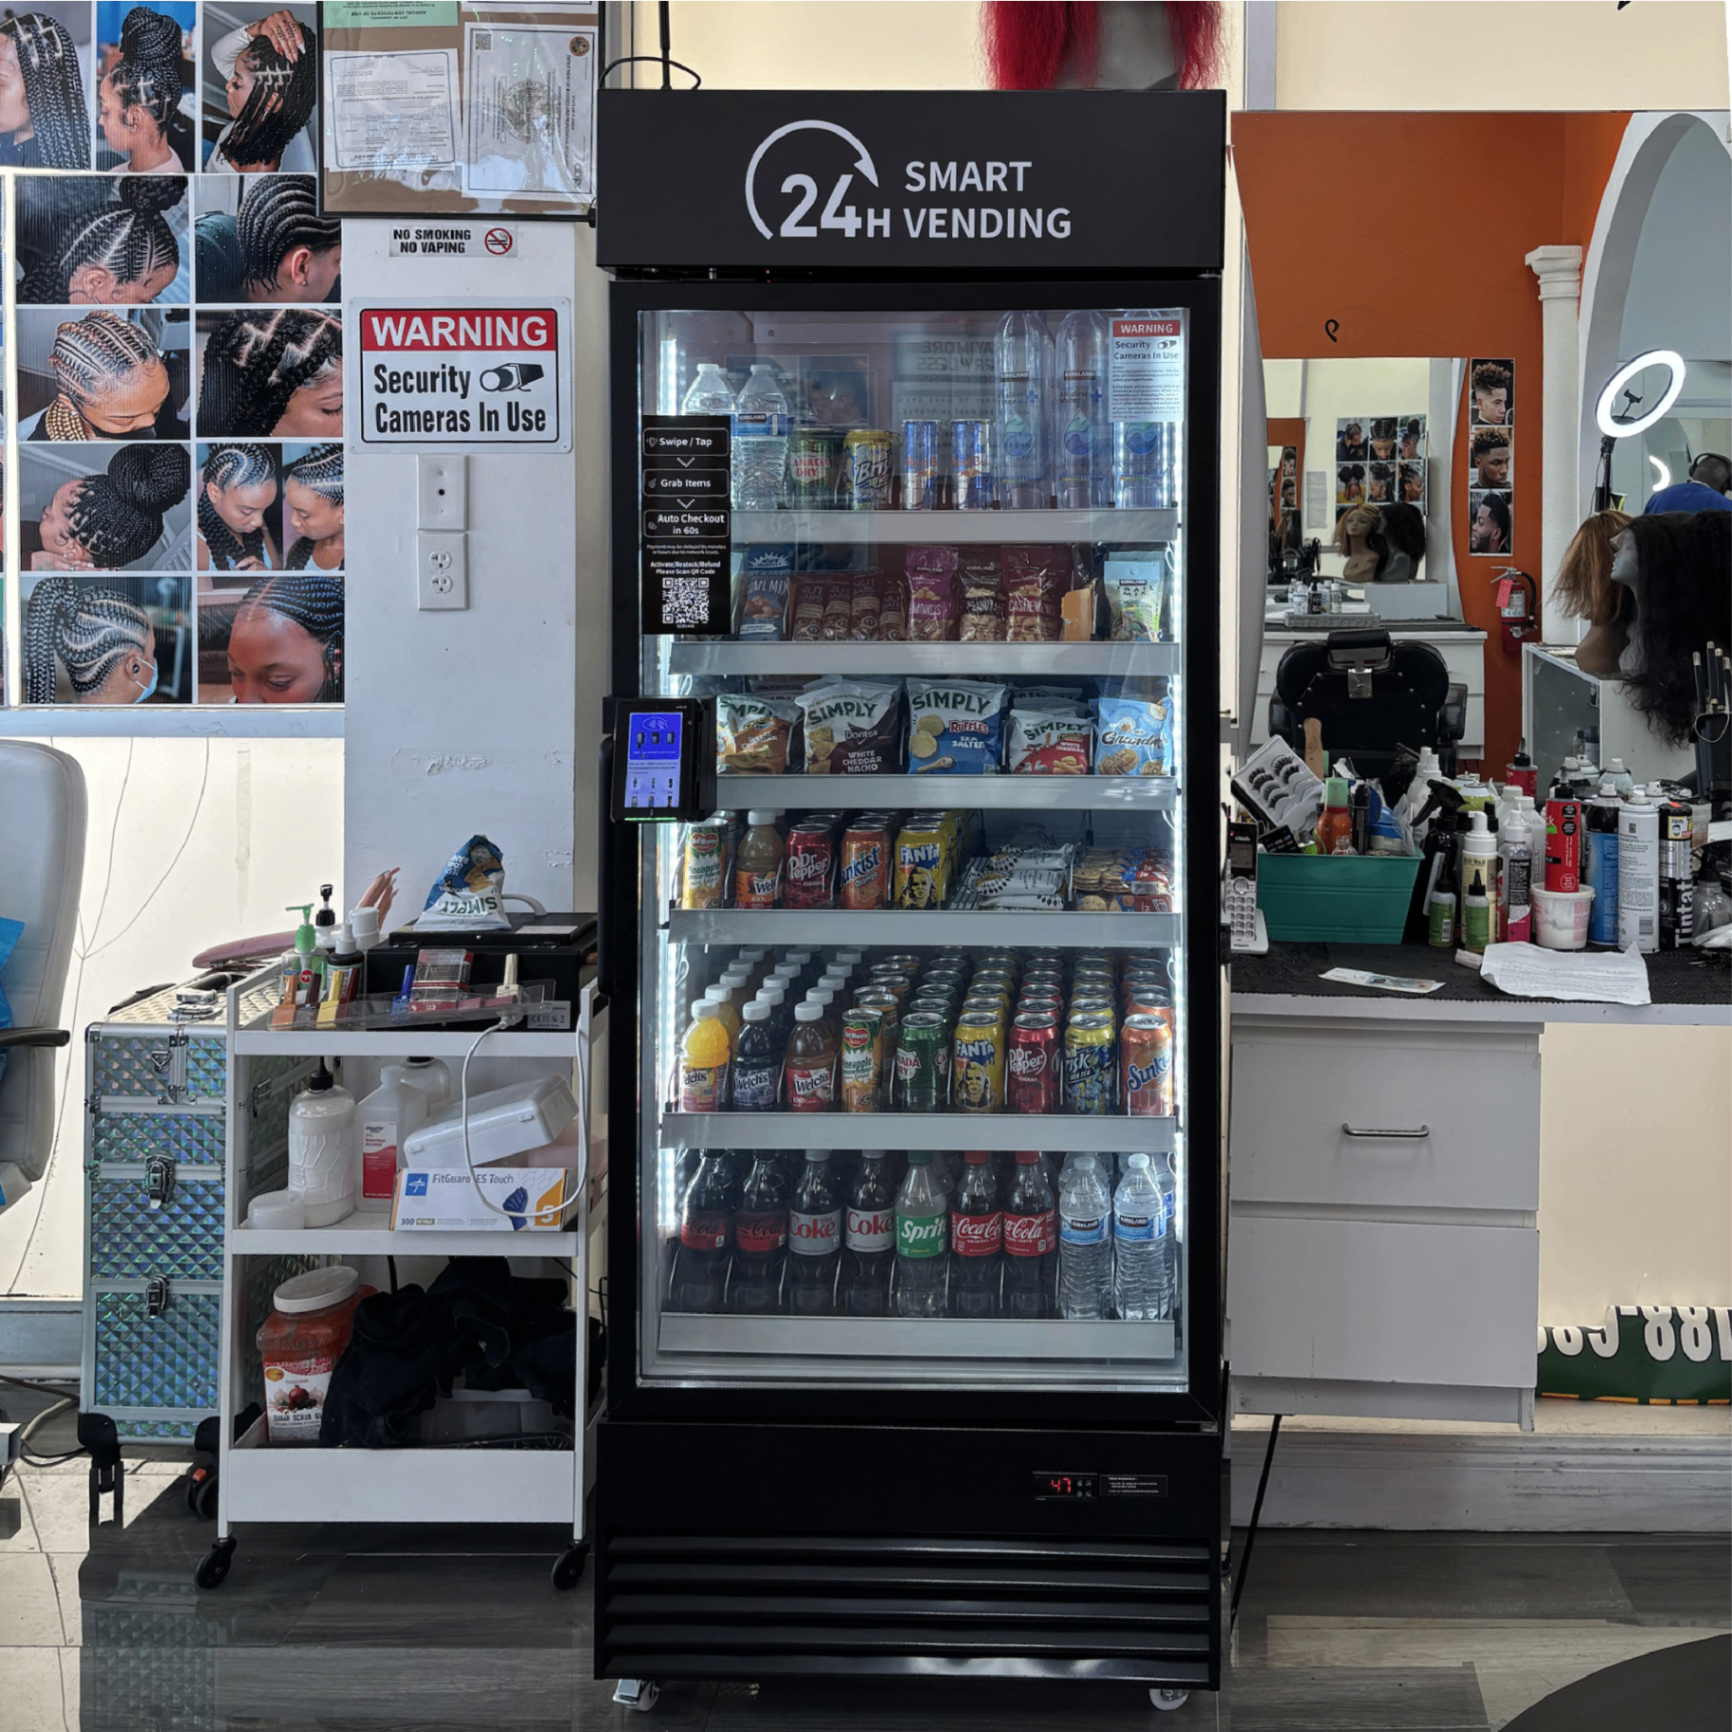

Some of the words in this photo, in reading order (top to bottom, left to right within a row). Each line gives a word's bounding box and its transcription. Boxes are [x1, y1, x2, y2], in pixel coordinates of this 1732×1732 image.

[905, 161, 1032, 192] SMART
[780, 173, 890, 238] 24H
[903, 208, 1071, 239] VENDING
[394, 230, 410, 240] NO
[415, 229, 471, 240] SMOKING
[400, 242, 416, 253] NO
[420, 242, 465, 253] VAPING
[371, 316, 547, 347] WARNING
[1121, 324, 1173, 334] WARNING
[1115, 341, 1151, 350] Security
[1114, 352, 1151, 360] Cameras
[374, 364, 471, 400] Security
[375, 402, 471, 433] Cameras
[479, 402, 499, 432] In
[507, 402, 546, 432] Use
[659, 438, 688, 447] Swipe
[689, 437, 694, 447] /
[695, 438, 713, 448] Tap
[797, 468, 818, 477] DRY
[661, 479, 683, 488] Grab
[686, 479, 711, 488] Items
[657, 514, 680, 524] Auto
[681, 514, 725, 524] Checkout
[673, 526, 682, 535] in
[683, 527, 700, 535] 60s
[912, 692, 991, 715] SIMPLY
[807, 701, 878, 726] SIMPLY
[950, 720, 989, 734] RUFFLES
[1024, 722, 1087, 741] SIMPLY
[845, 729, 878, 741] Doritos
[952, 740, 986, 749] SALTED
[842, 756, 883, 766] CHEDDAR
[848, 750, 875, 758] WHITE
[847, 763, 879, 773] NACHO
[801, 853, 817, 869] Dr
[900, 845, 940, 862] FANTA
[788, 857, 828, 880] Pepper
[855, 872, 879, 887] Orange
[437, 897, 498, 915] SIMPLY
[956, 1040, 995, 1058] FANTA
[1016, 1049, 1032, 1061] Dr
[1010, 1050, 1044, 1075] Pepper
[685, 1072, 707, 1086] elch's
[735, 1073, 768, 1091] Welch's
[796, 1073, 829, 1095] Welch's
[476, 1174, 487, 1183] ES
[489, 1174, 514, 1184] Touch
[789, 1214, 836, 1239] Coke
[847, 1211, 894, 1236] Coke
[902, 1217, 946, 1244] Sprit
[1051, 1478, 1071, 1494] 47
